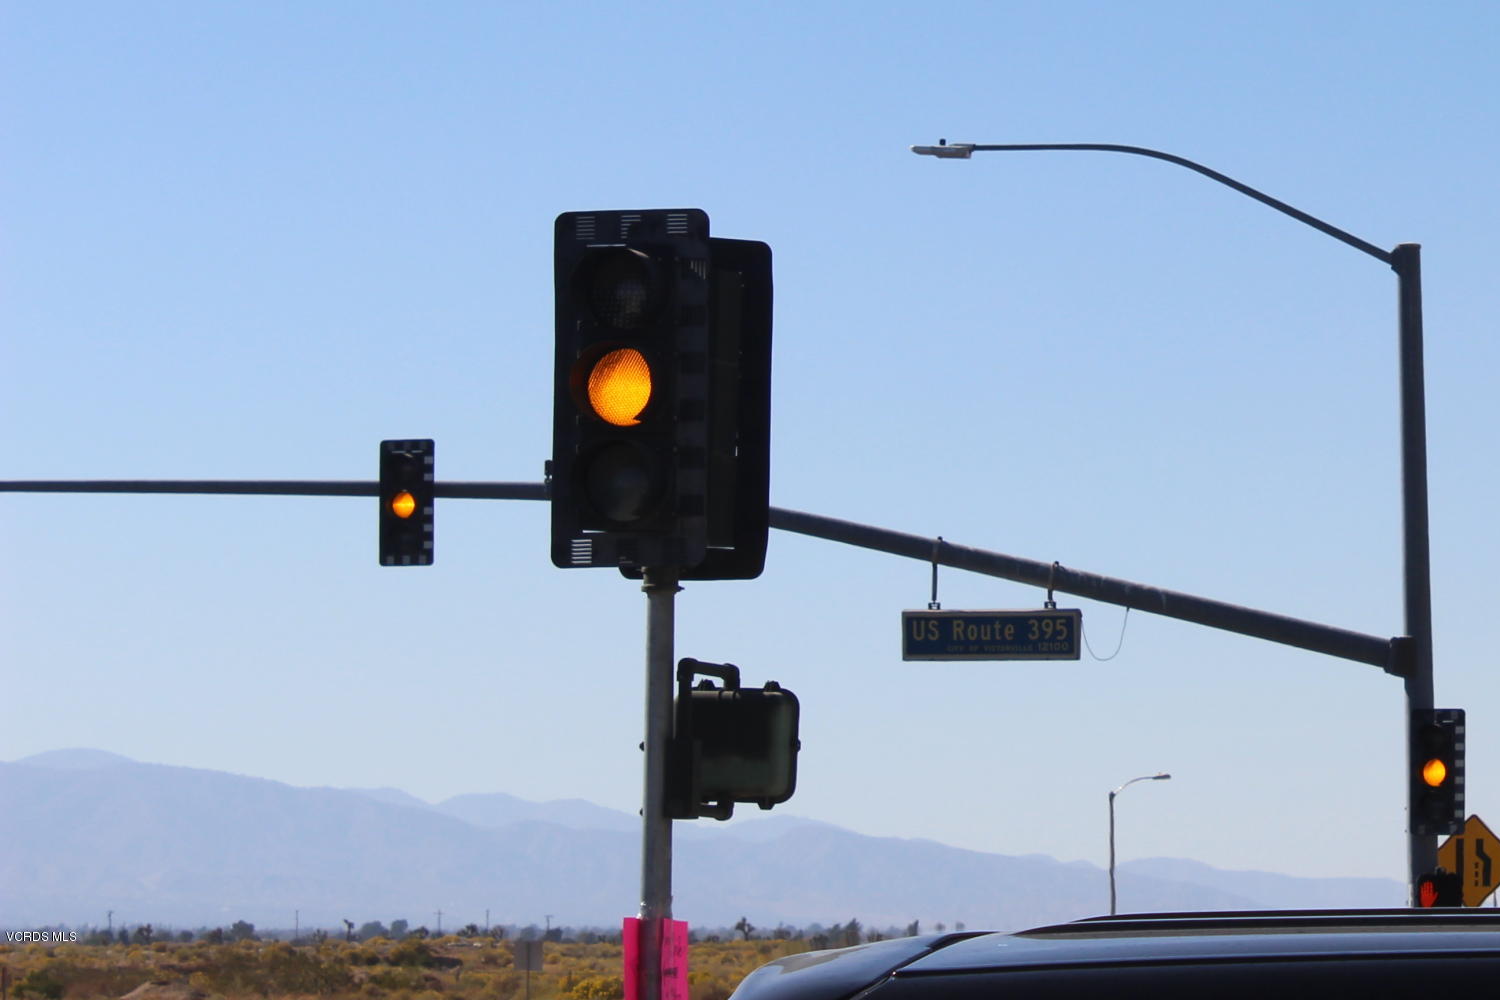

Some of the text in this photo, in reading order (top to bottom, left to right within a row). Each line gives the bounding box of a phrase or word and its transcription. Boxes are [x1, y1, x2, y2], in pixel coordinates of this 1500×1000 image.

[912, 618, 1068, 641] US Route 395
